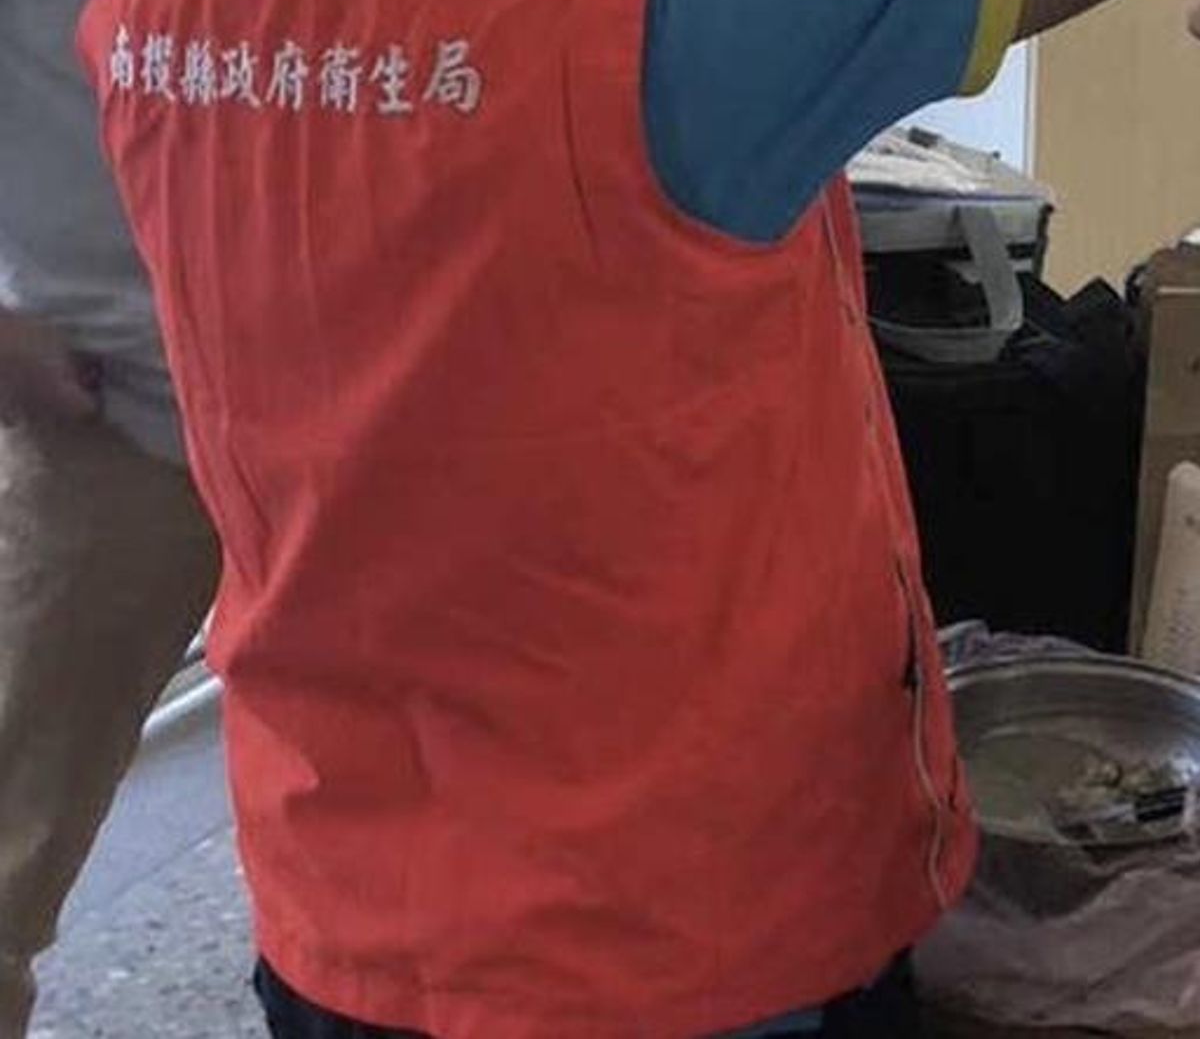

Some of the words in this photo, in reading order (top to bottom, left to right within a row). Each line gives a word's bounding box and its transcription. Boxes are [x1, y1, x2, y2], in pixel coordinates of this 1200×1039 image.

[109, 23, 483, 113] 南投縣政府衛生局
